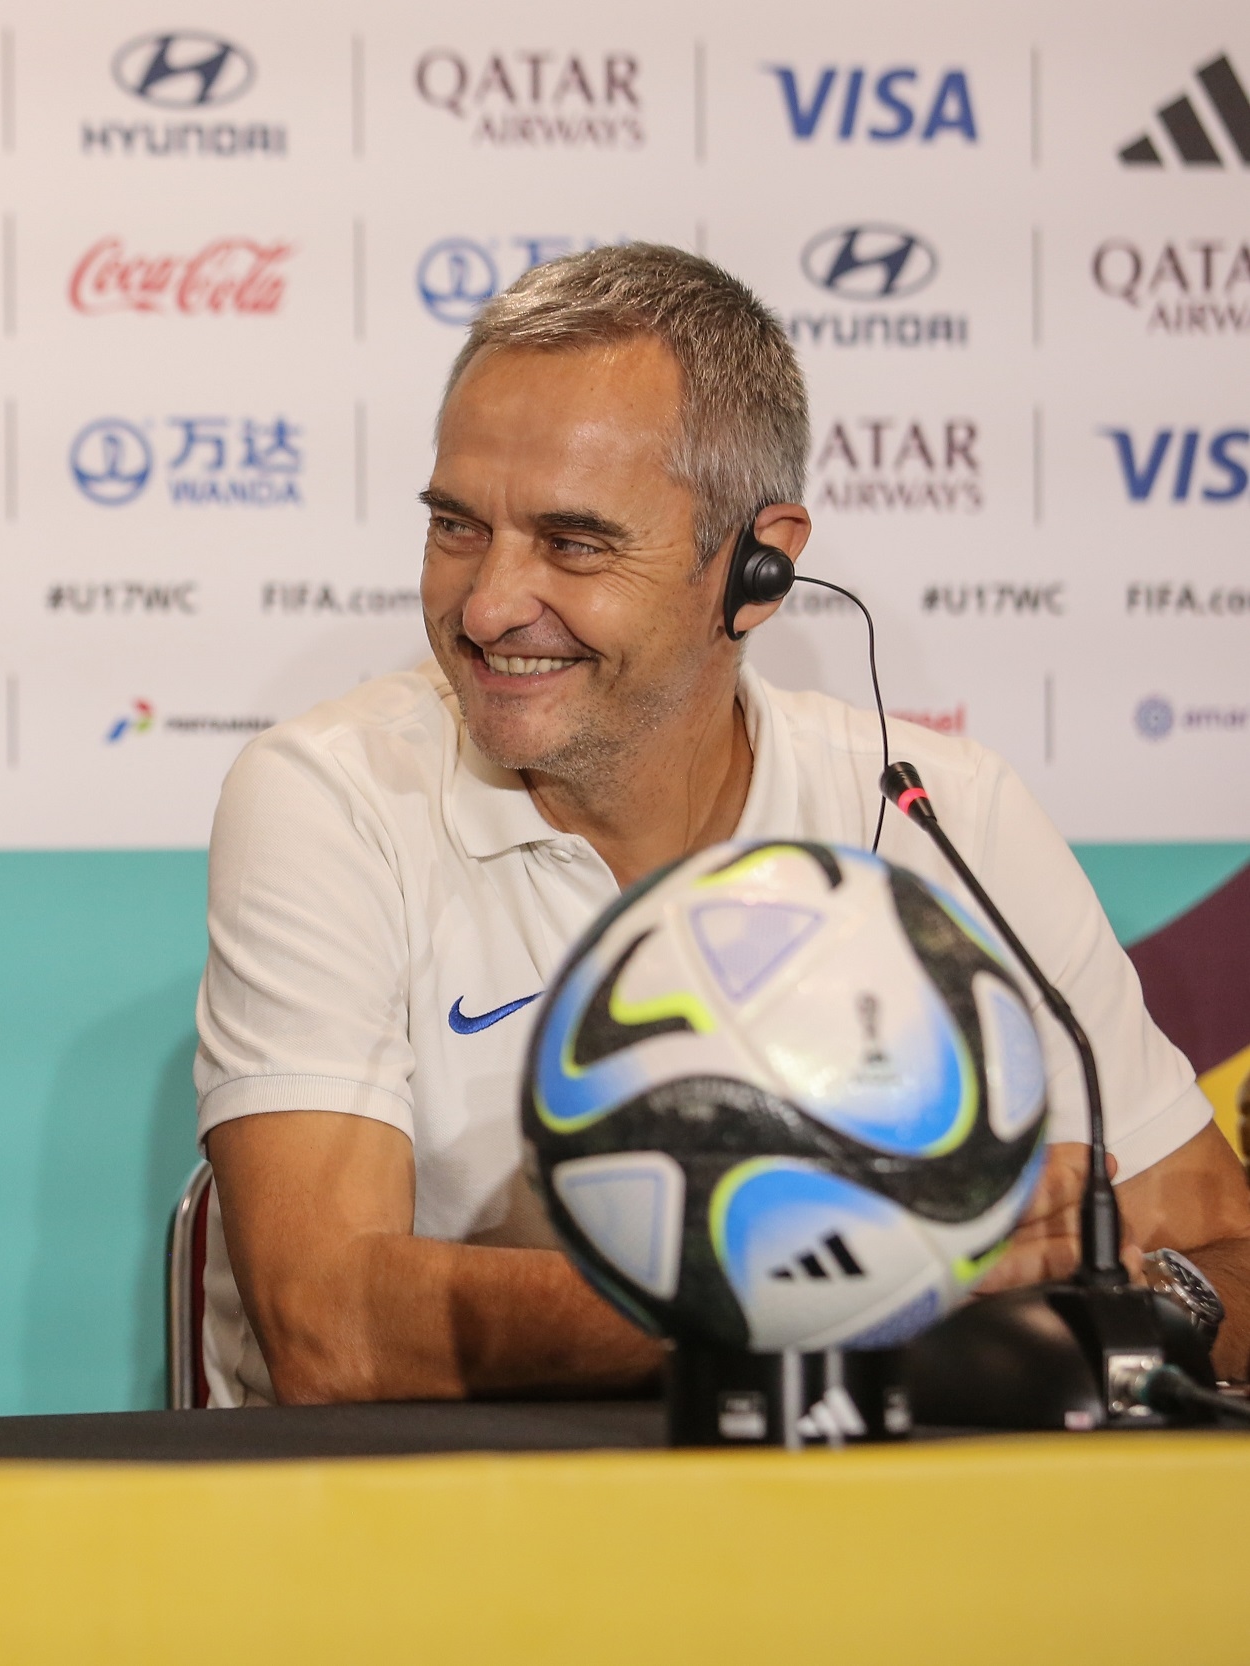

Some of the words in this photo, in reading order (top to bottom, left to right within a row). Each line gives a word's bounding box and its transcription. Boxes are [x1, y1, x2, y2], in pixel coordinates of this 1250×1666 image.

[414, 50, 642, 119] QATAR
[762, 63, 980, 143] VISA
[81, 122, 287, 157] HYUNDAI
[475, 115, 646, 147] AIRWAYS
[166, 416, 303, 473] 万达
[816, 419, 981, 472] ATAR
[168, 480, 303, 505] WANDA
[816, 482, 985, 511] AIRWAYS
[46, 581, 197, 614] #U17WC
[921, 582, 1063, 615] #U17WC
[1126, 582, 1250, 615] FIFA.co
